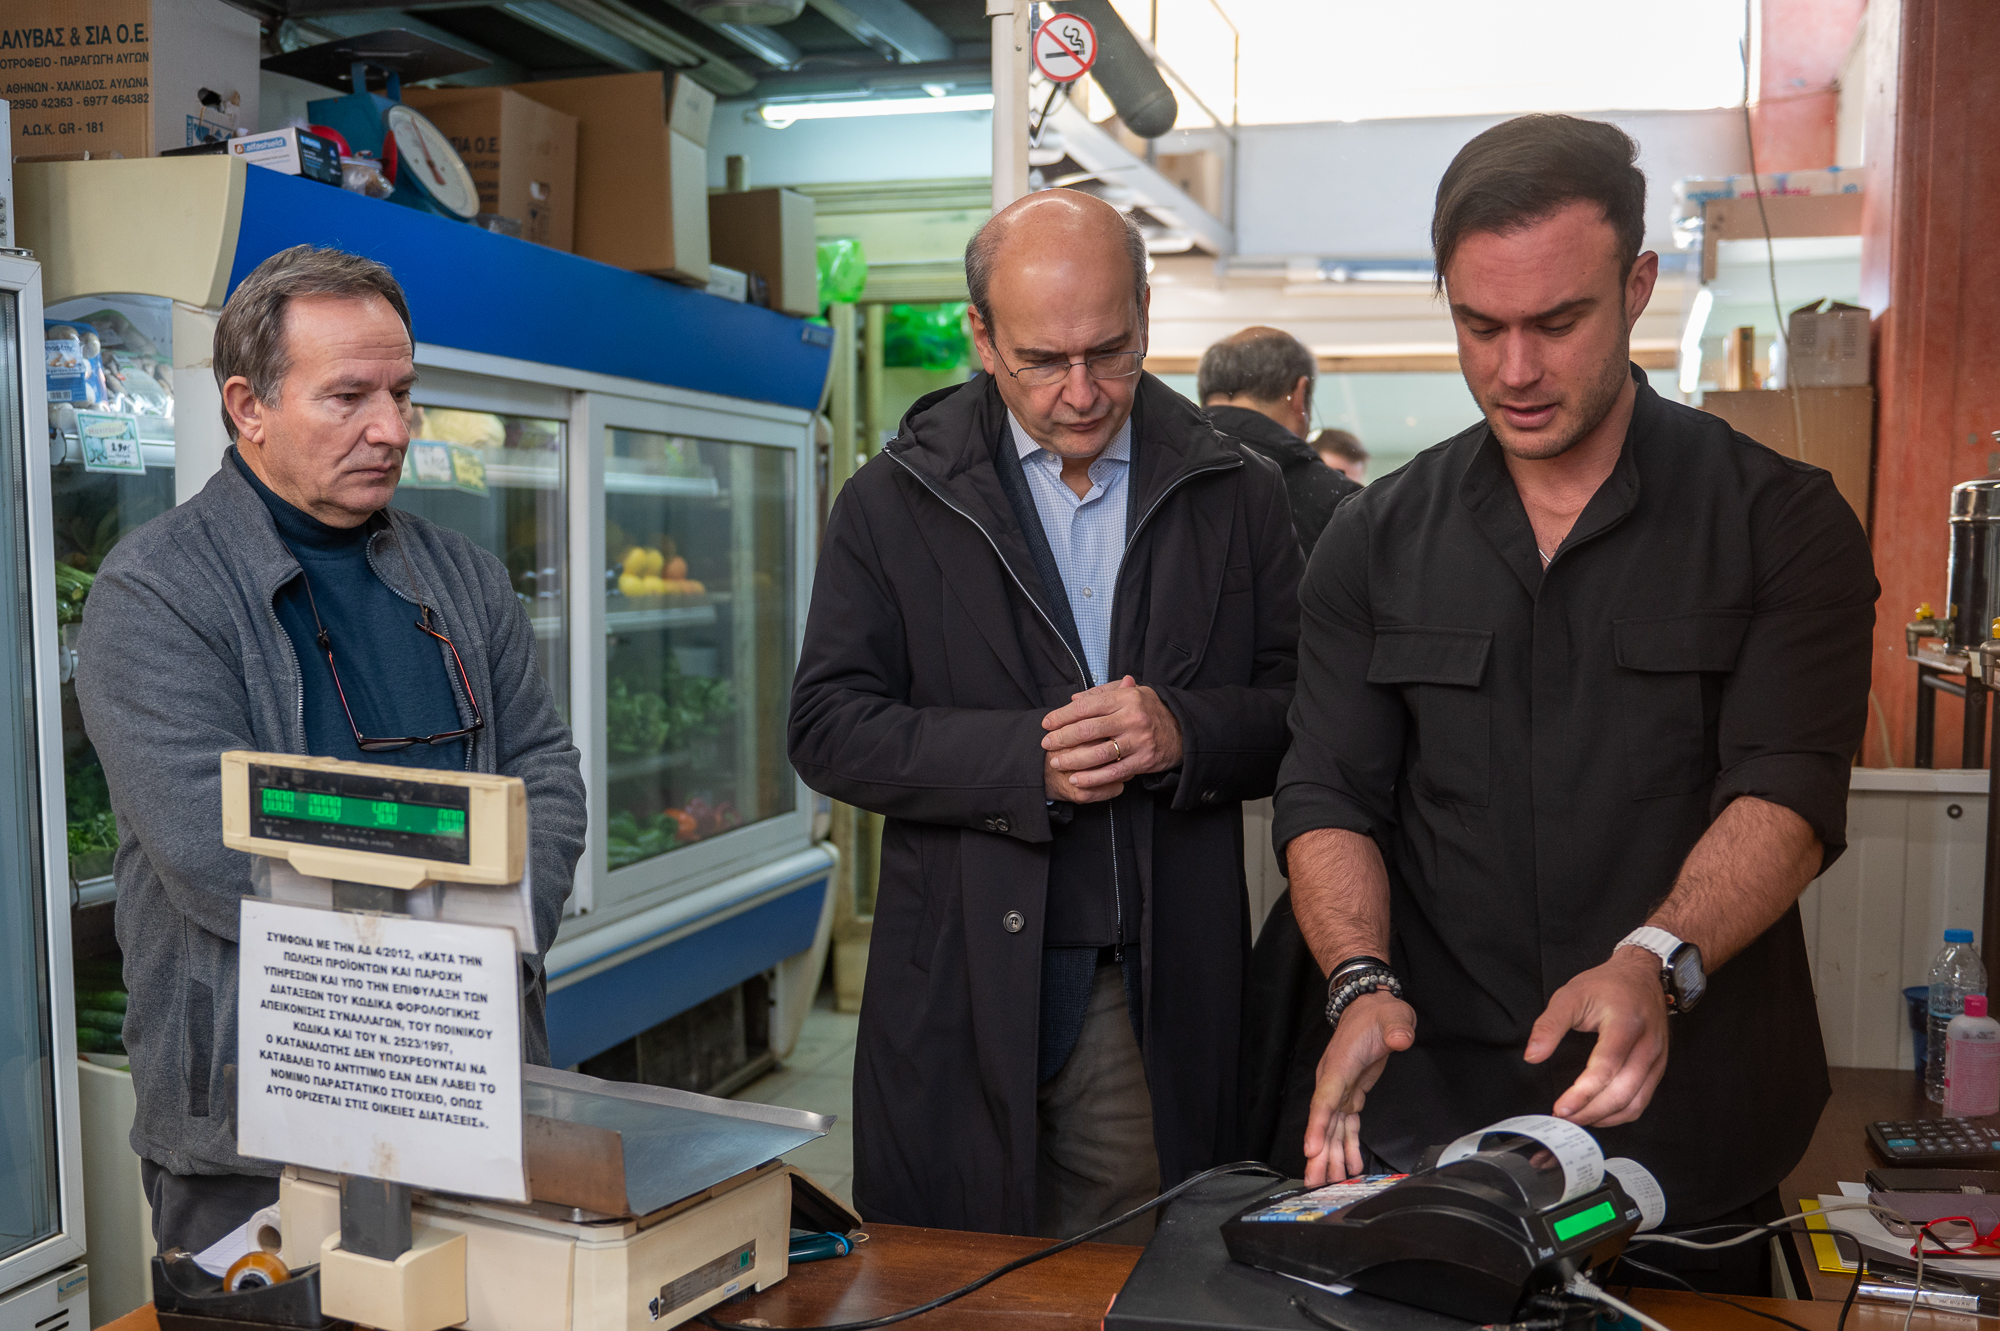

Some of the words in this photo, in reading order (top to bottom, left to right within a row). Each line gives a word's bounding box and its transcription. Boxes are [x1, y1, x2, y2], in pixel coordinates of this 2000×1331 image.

[70, 27, 81, 46] &
[85, 25, 112, 45] ΣΙΑ
[116, 23, 149, 44] Ο.Ε.
[60, 54, 113, 66] ΠΑΡΑΓΩΓΗ
[116, 52, 149, 63] ΑΥΓΩΝ
[6, 82, 48, 94] ΑΘΗΝΩΝ
[110, 77, 149, 89] ΑΥΛΩΝΑ
[41, 97, 73, 108] 42363
[83, 95, 108, 106] 6977
[111, 93, 149, 105] 464382
[59, 122, 75, 134] GR
[86, 121, 104, 133] 181
[267, 932, 313, 948] ΣΥΜΦΩΝΑ
[317, 939, 330, 950] ΜΕ
[334, 941, 354, 953] ΤΗΝ
[358, 944, 372, 955] ΑΔ
[459, 954, 482, 967] ΤΗΝ
[284, 952, 322, 967] ΠΩΛΗΣΗ
[392, 966, 411, 977] ΚΑΙ
[415, 968, 462, 982] ΠΑΡΟΧΗ
[321, 975, 338, 986] ΚΑΙ
[342, 978, 363, 989] ΥΠΟ
[367, 981, 388, 992] ΤΗΝ
[464, 992, 488, 1003] ΤΩΝ
[328, 992, 348, 1004] ΤΟΥ
[352, 996, 392, 1010] ΚΩΔΙΚΑ
[294, 1021, 330, 1036] ΚΩΔΙΚΑ
[334, 1028, 351, 1039] ΚΑΙ
[356, 1031, 376, 1042] ΤΟΥ
[408, 1020, 431, 1032] ΤΟΥ
[435, 1024, 492, 1040] ΠΟΙΝΙΚΟΥ
[266, 1034, 273, 1043] Ο
[354, 1048, 375, 1060] ΔΕΝ
[470, 1063, 486, 1075] ΝΑ
[317, 1060, 330, 1070] ΤΟ
[334, 1062, 386, 1078] ΑΝΤΙΤΙΜΟ
[390, 1070, 411, 1082] ΕΑΝ
[416, 1074, 438, 1086] ΔΕΝ
[442, 1078, 476, 1091] ΛΑΒΕΙ
[480, 1083, 496, 1094] ΤΟ
[271, 1068, 310, 1083] ΝΟΜΙΜΟ
[450, 1096, 482, 1110] ΟΠΩΣ
[266, 1084, 292, 1098] ΑΥΤΟ
[296, 1090, 341, 1106] ΟΡΙΖΕΤΑΙ
[345, 1098, 368, 1110] ΣΤΙΣ
[372, 1102, 415, 1118] ΟΙΚΕΙΕΣ
